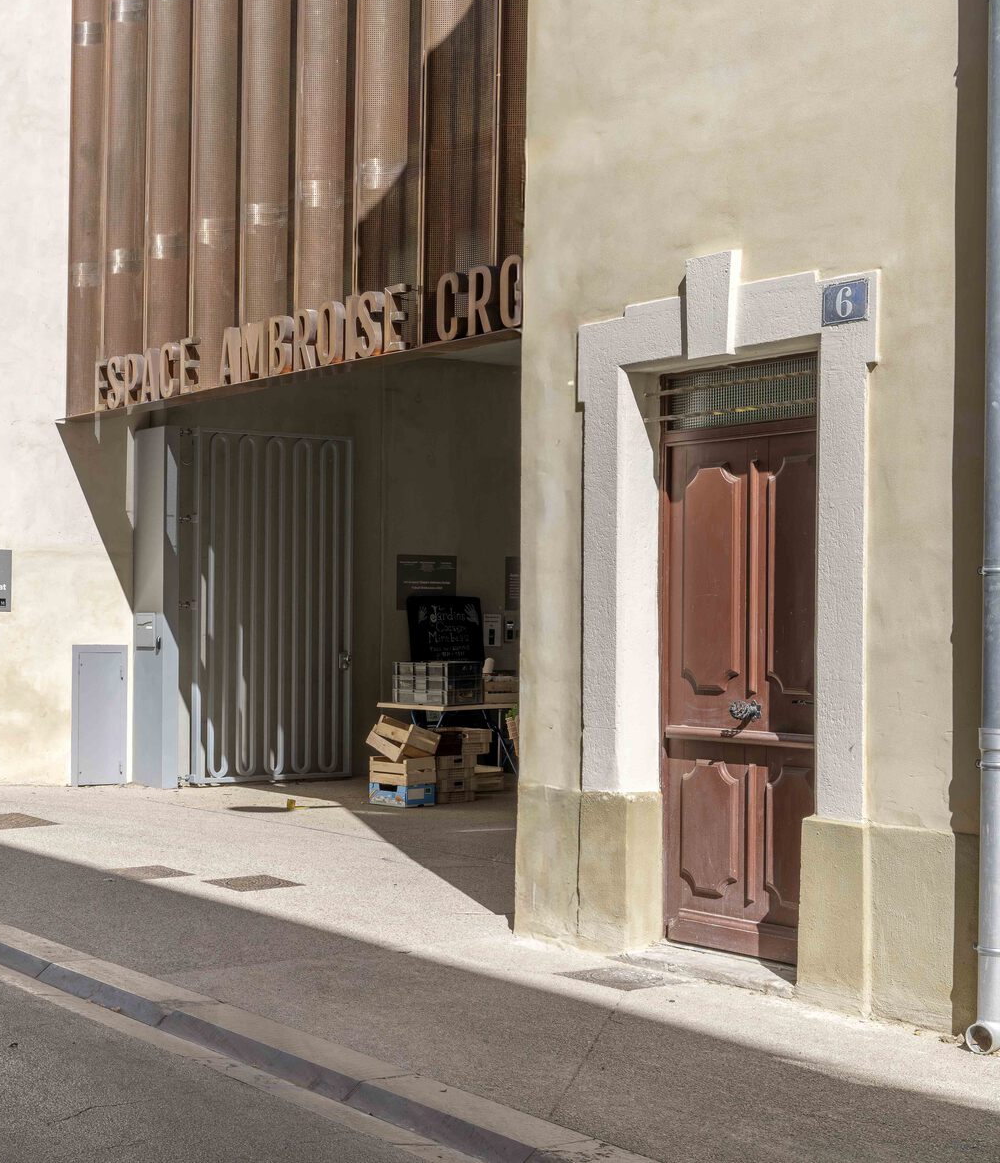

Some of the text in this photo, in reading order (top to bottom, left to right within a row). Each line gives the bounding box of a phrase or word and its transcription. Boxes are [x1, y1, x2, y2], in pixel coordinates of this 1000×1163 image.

[835, 286, 853, 318] 6
[94, 336, 201, 412] ESPACE
[219, 283, 410, 386] AMBROISE
